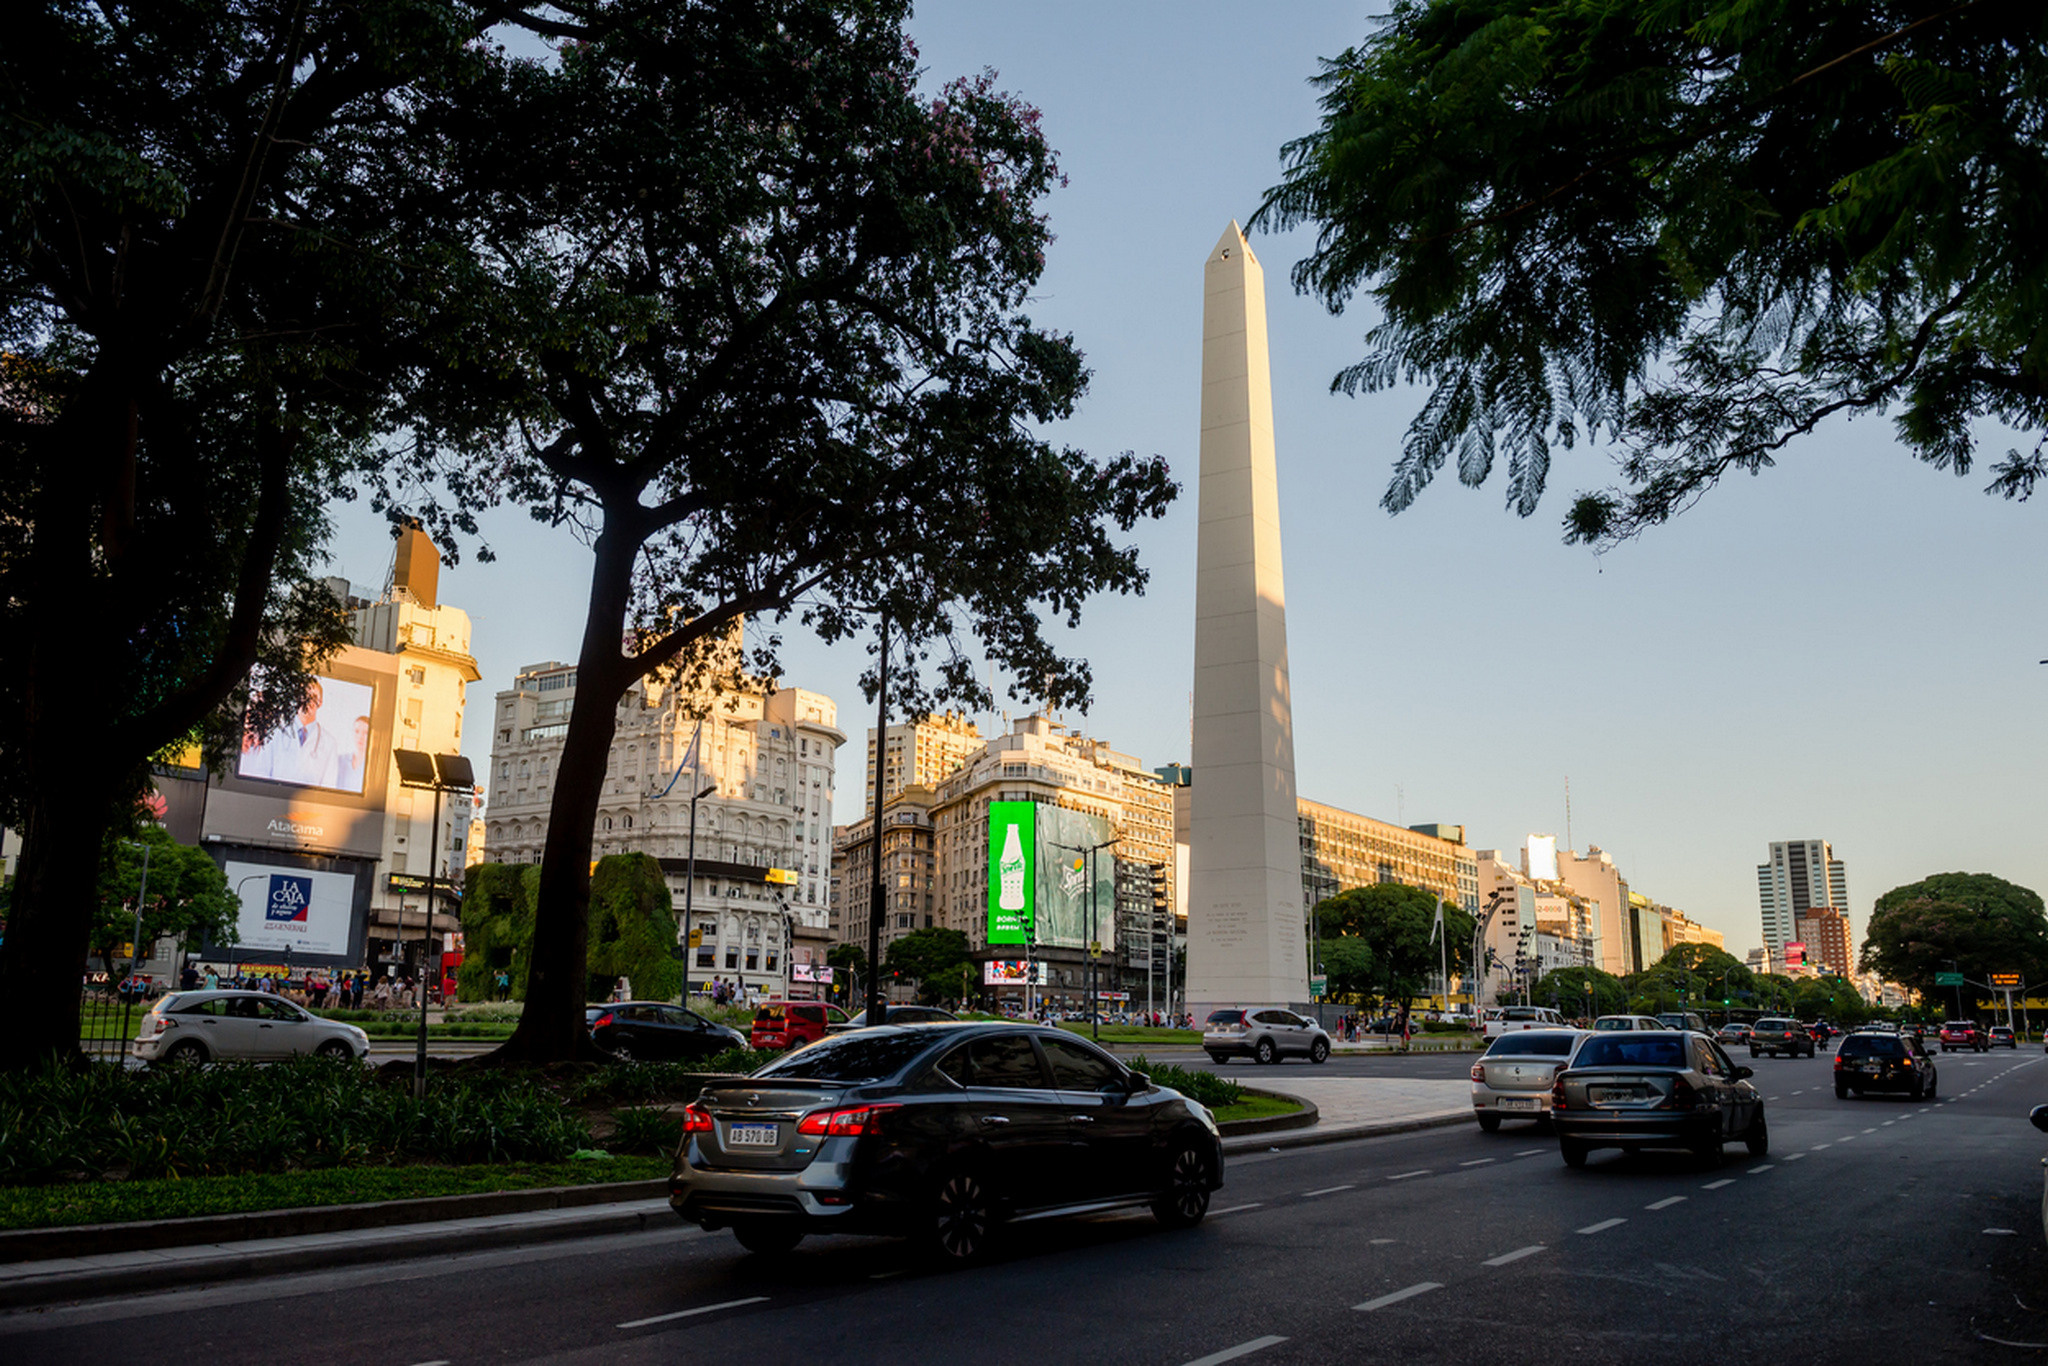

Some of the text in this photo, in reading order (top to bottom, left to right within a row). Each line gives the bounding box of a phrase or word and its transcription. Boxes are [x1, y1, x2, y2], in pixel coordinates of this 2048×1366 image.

[267, 819, 323, 836] Atacama
[283, 880, 299, 892] LA
[272, 891, 305, 905] CAJA
[240, 965, 282, 974] MAXIKIOSCO
